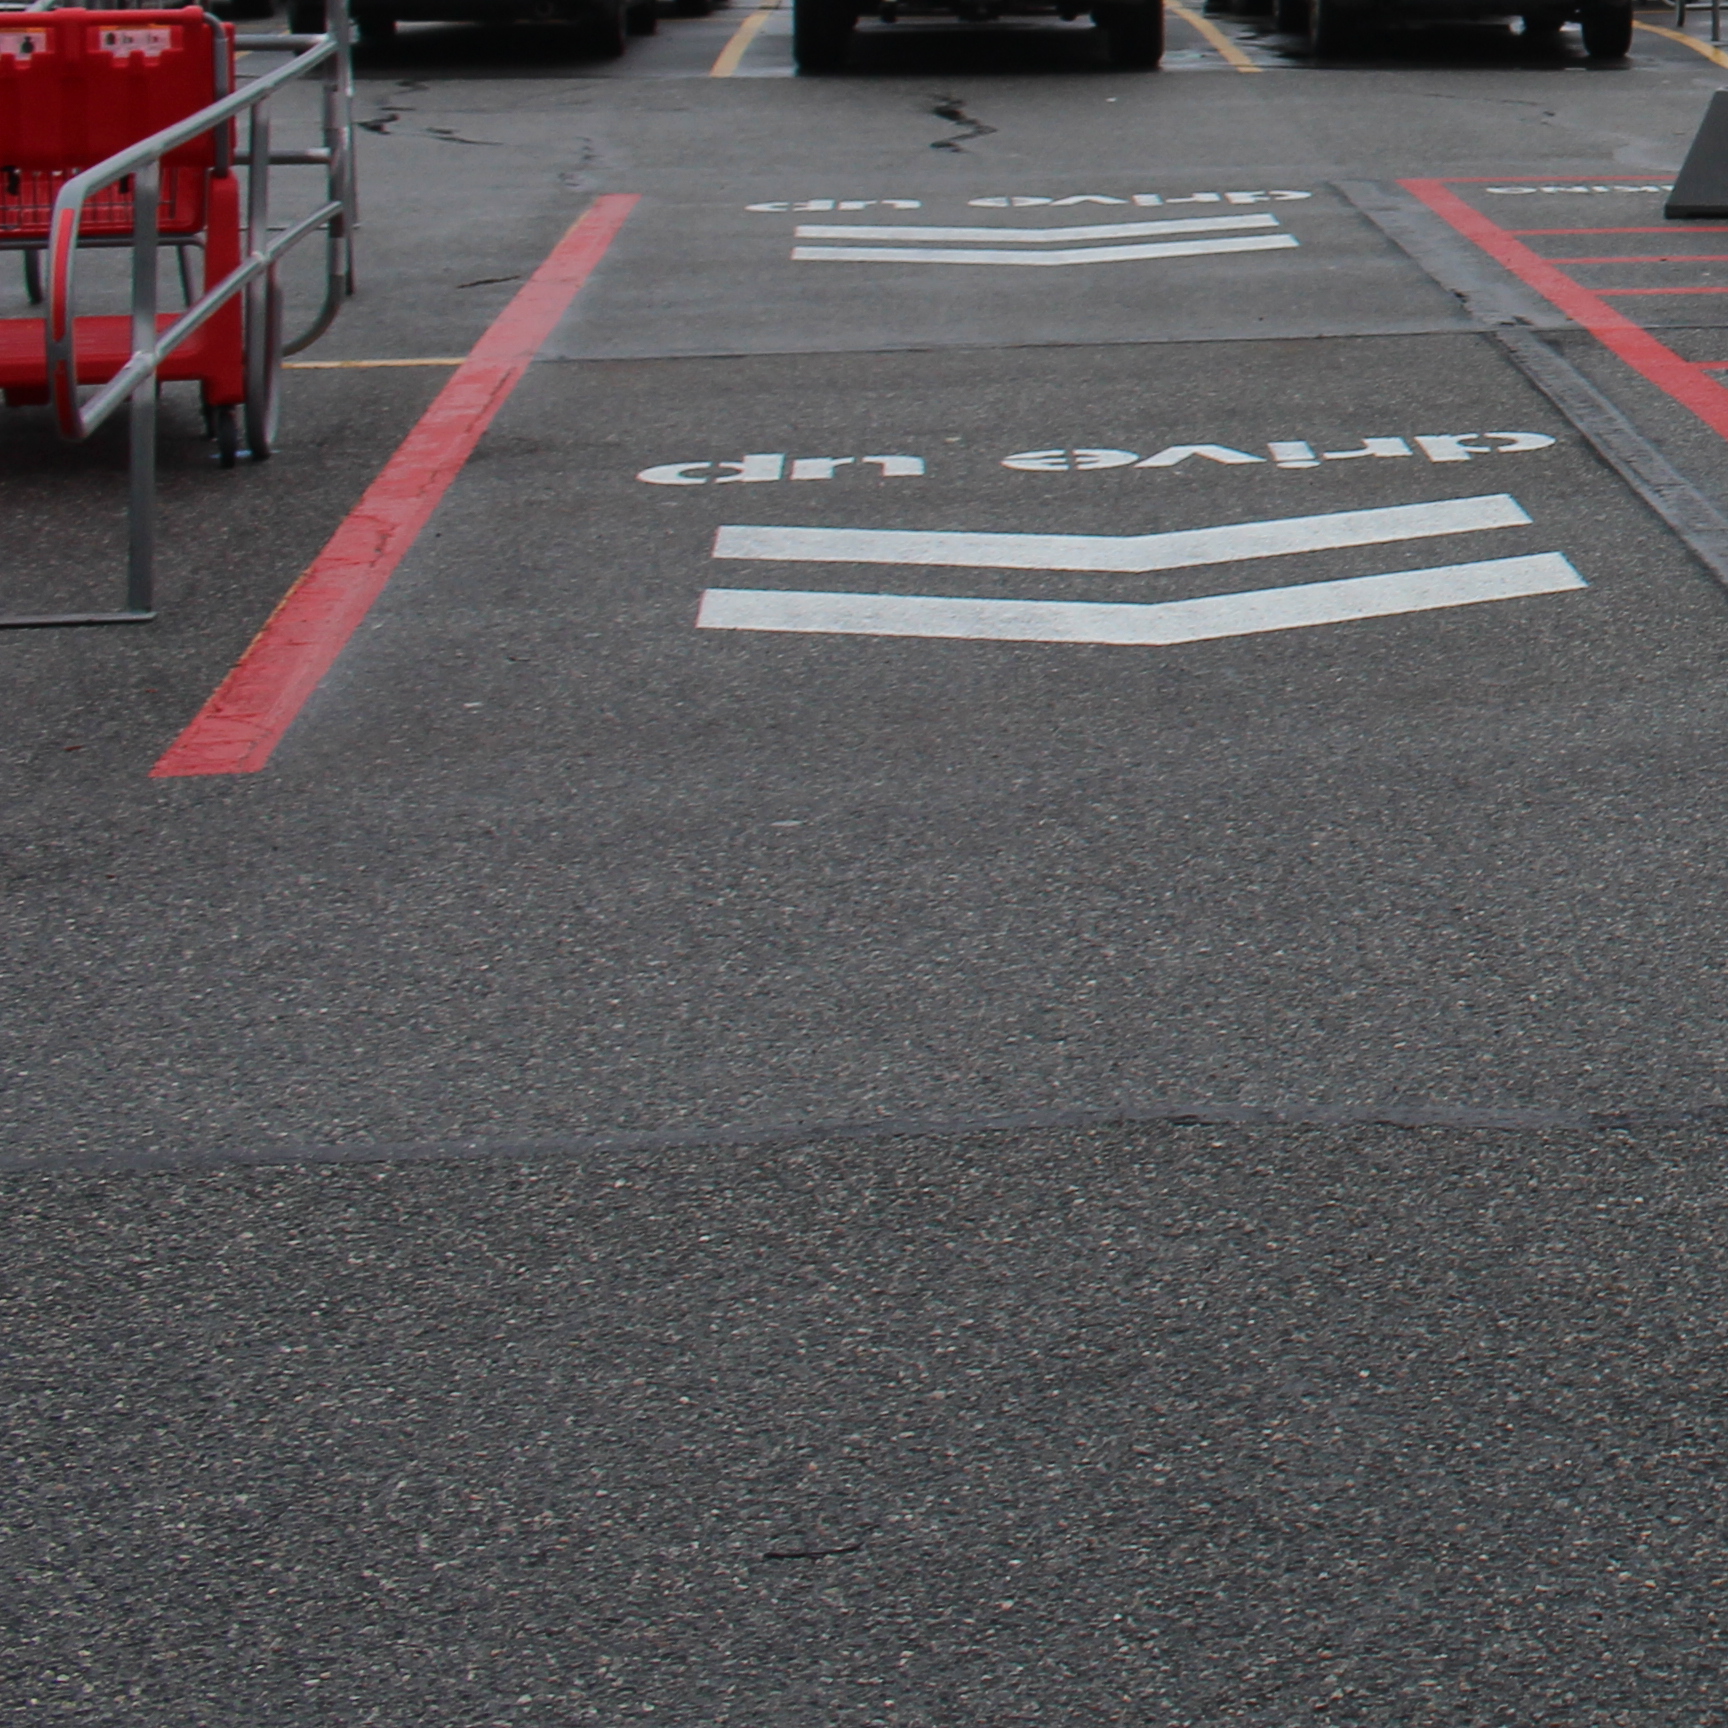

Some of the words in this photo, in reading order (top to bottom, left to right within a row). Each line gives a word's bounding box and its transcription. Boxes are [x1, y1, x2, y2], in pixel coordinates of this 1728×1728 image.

[745, 199, 921, 212] up
[967, 190, 1313, 208] drive
[1000, 430, 1555, 472] drive
[635, 453, 926, 485] up
